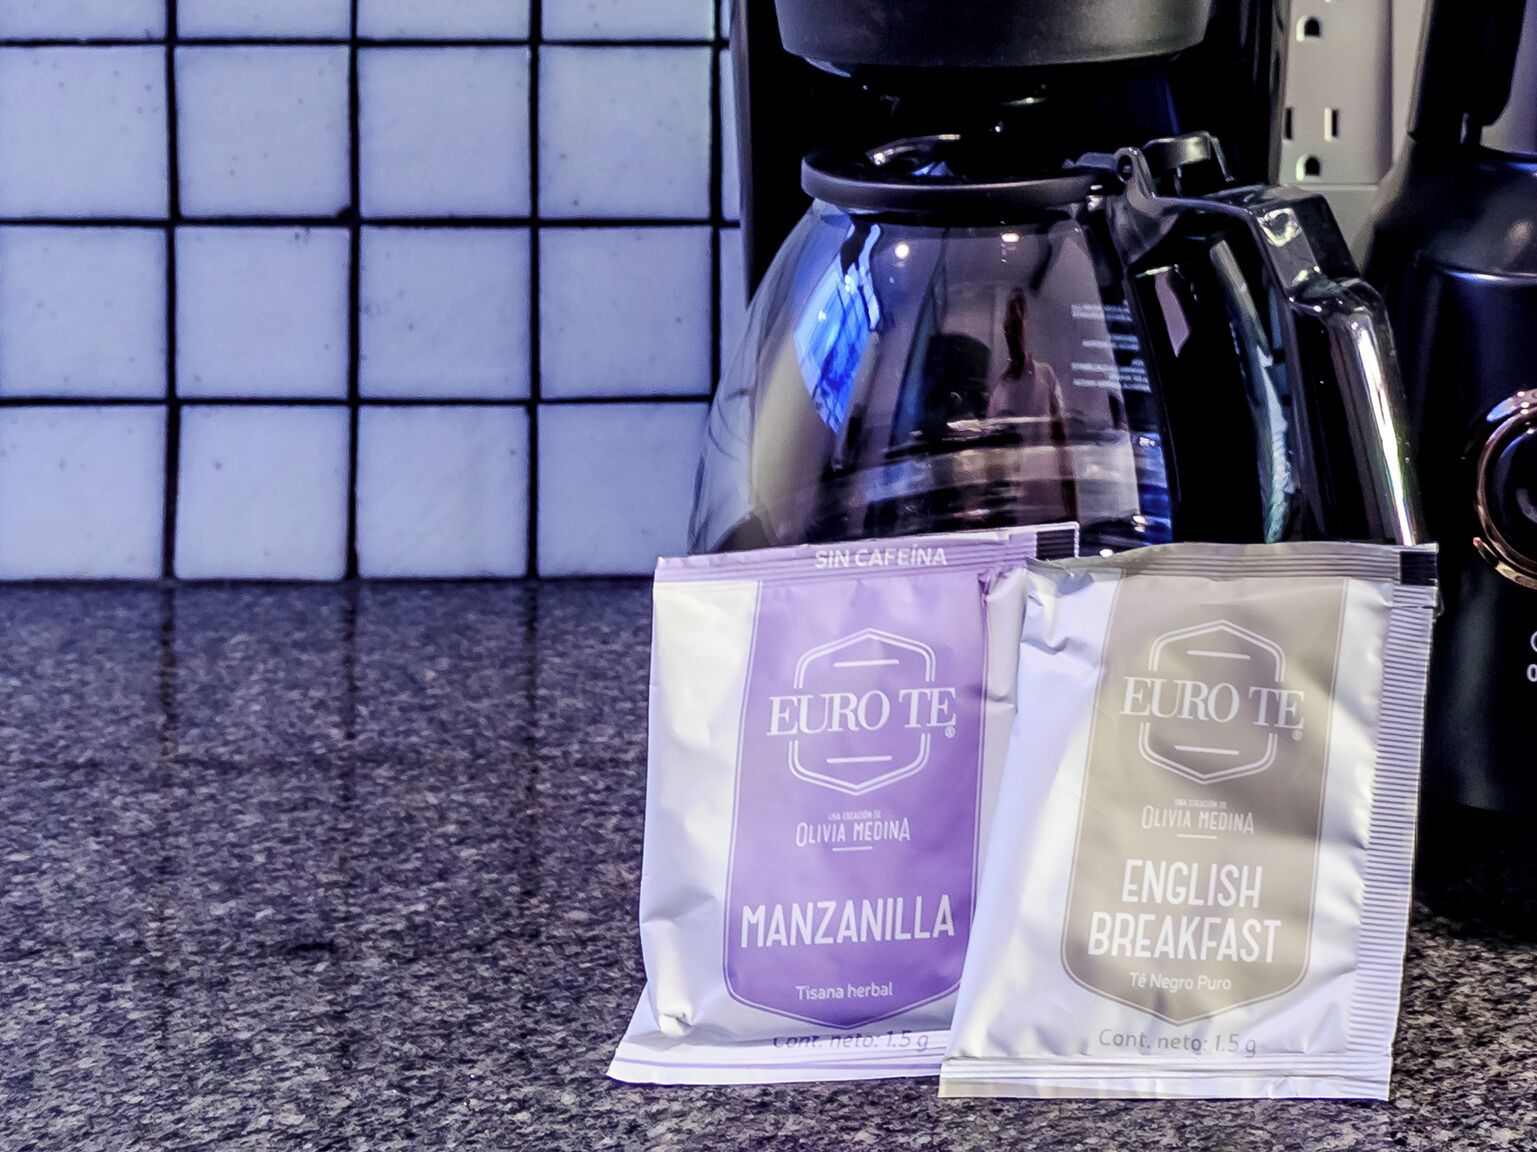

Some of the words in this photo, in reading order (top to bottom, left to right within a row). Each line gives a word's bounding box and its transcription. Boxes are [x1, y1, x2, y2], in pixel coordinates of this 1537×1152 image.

[815, 549, 849, 568] SIN
[855, 544, 948, 567] CAFEÍNA
[766, 690, 891, 736] EURO
[1120, 676, 1240, 723] EURO
[795, 822, 846, 847] OLIVIA
[853, 817, 911, 841] MEDINA
[1141, 804, 1191, 829] OLIVIA
[1198, 811, 1254, 835] MEDINA
[1122, 859, 1262, 908] ENGLISH
[741, 894, 955, 948] MANZANILLA
[1088, 911, 1282, 963] BREAKFAST
[795, 984, 844, 1000] Tisana
[847, 982, 893, 998] herbal
[1129, 972, 1147, 988] Té
[1149, 973, 1194, 993] Negro
[1197, 975, 1232, 991] Puro
[886, 1030, 912, 1048] 1.5
[916, 1034, 929, 1052] g
[1098, 1028, 1151, 1049] Cont.
[1157, 1034, 1208, 1051] neto:
[1214, 1032, 1240, 1053] 1.5
[1244, 1039, 1257, 1058] g
